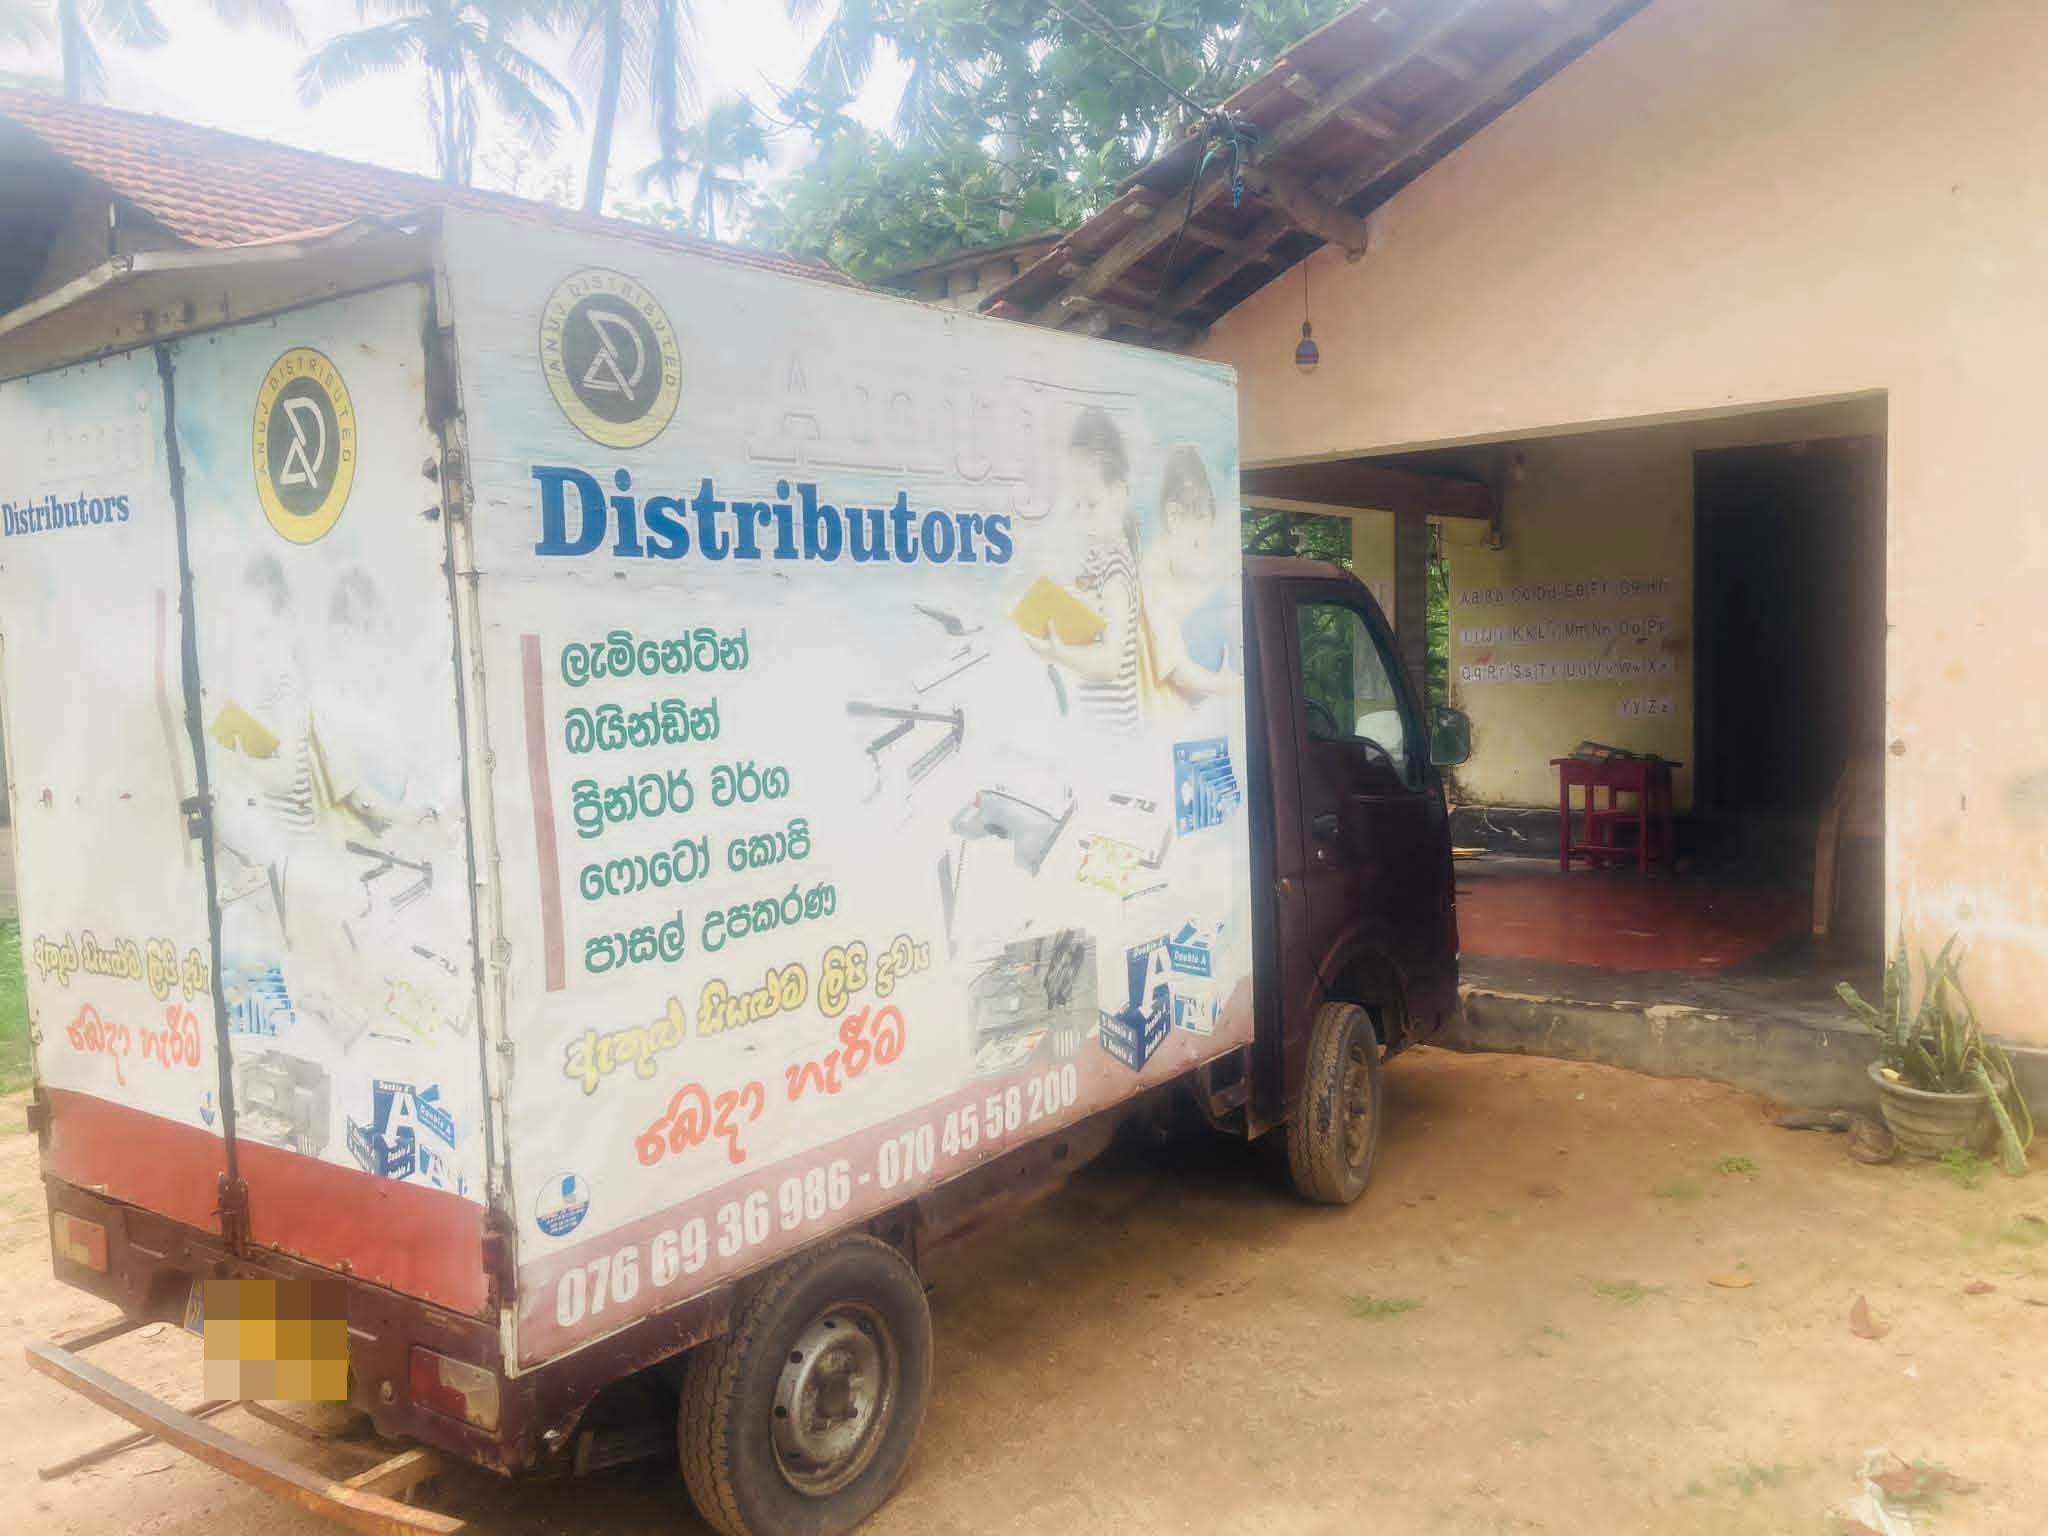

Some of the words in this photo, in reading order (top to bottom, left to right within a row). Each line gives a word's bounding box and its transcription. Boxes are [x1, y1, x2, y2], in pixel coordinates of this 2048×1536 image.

[1, 490, 130, 537] Distributors
[532, 463, 1014, 565] Distributors
[564, 696, 721, 755] බයින්ඩින්
[710, 760, 790, 807] වර්ග
[579, 834, 710, 901] ෆොටෝ
[583, 909, 686, 974] පාසල්
[702, 881, 838, 953] උපකරණ
[555, 1244, 641, 1328] 076
[651, 1216, 708, 1288] 69
[717, 1187, 770, 1259] 36
[777, 1158, 851, 1228] 986
[877, 1124, 935, 1190] 070
[940, 1102, 980, 1158] 45
[984, 1085, 1022, 1132] 58
[1026, 1062, 1078, 1118] 200
